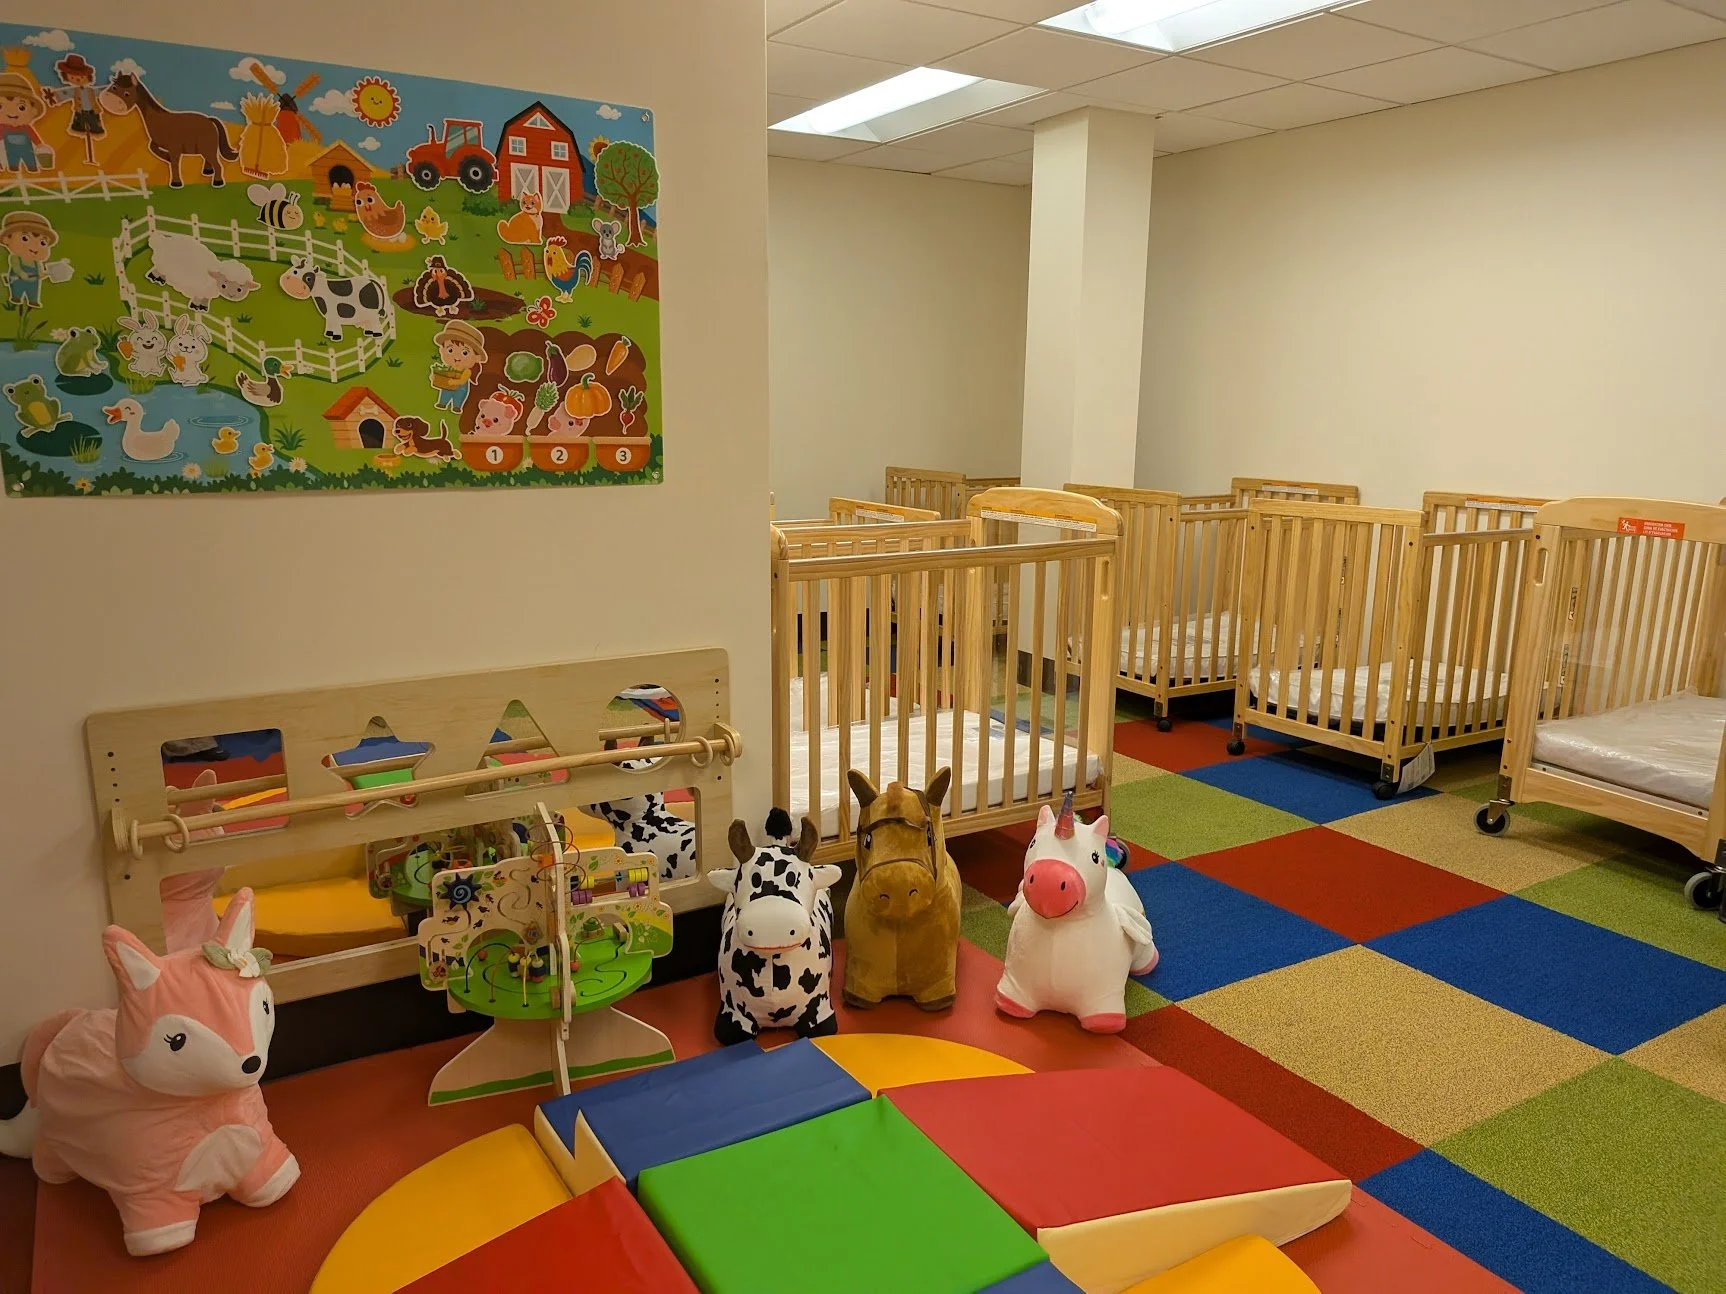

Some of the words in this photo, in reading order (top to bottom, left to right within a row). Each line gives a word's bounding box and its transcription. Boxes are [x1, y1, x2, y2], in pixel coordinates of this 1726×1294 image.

[491, 449, 498, 462] 1
[555, 449, 565, 461] 2
[619, 450, 628, 462] 3
